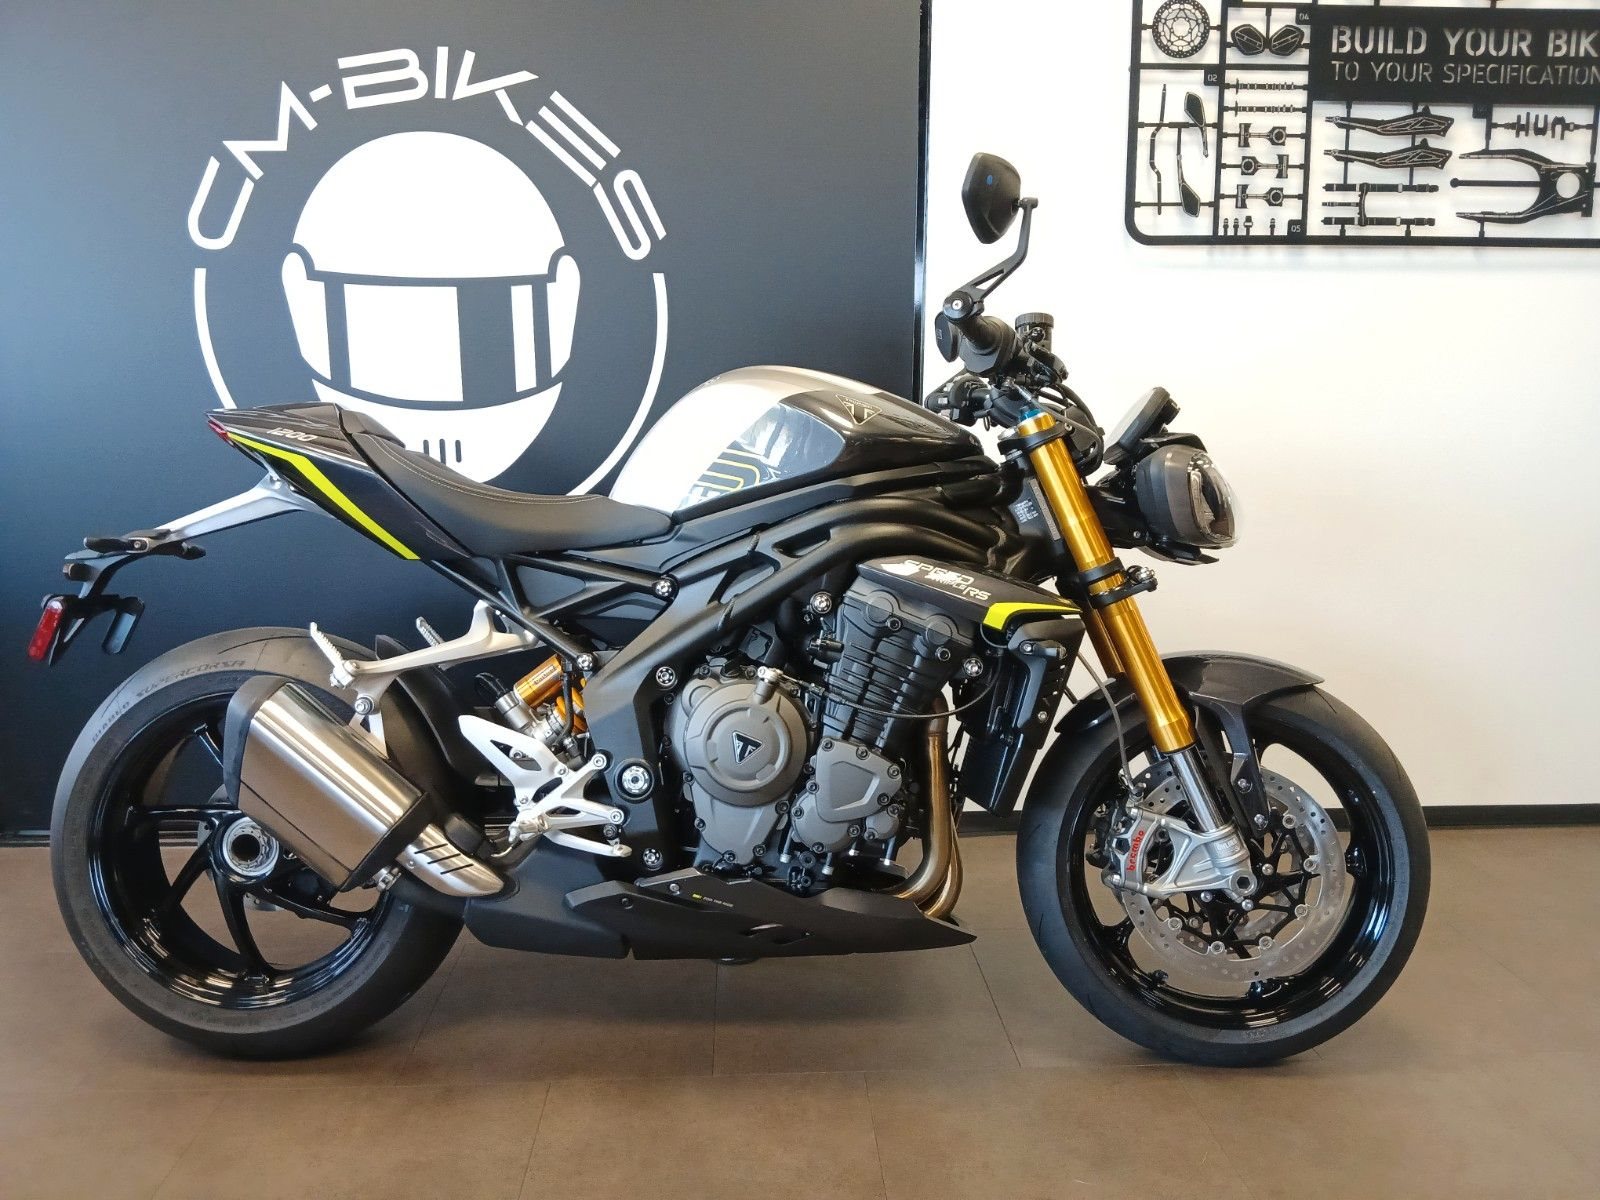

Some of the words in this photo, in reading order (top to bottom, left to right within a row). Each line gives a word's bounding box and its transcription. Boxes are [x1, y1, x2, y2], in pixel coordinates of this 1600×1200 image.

[1331, 25, 1428, 55] BUILD
[1443, 27, 1533, 57] YOUR
[1207, 73, 1218, 82] 02
[1331, 60, 1360, 81] TO
[1370, 61, 1433, 83] YOUR
[1290, 224, 1301, 233] 05
[266, 427, 319, 442] 1200
[962, 586, 992, 601] RS
[1126, 830, 1146, 872] brembo
